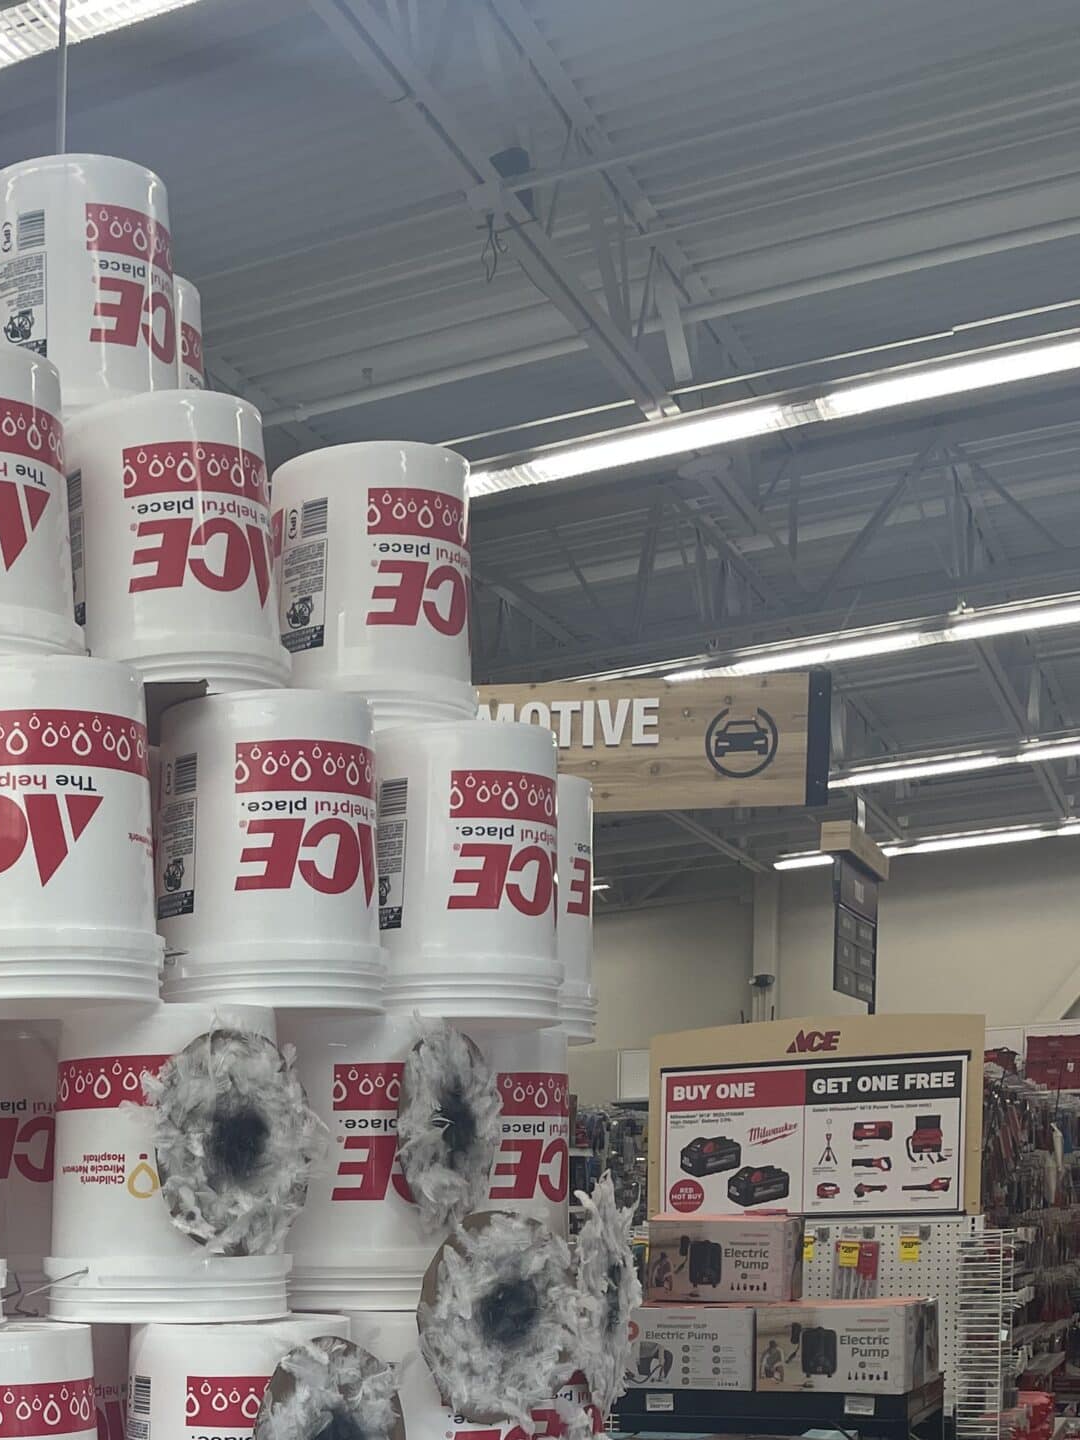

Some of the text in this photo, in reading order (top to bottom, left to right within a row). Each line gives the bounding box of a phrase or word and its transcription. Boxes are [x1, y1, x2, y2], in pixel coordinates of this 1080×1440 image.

[16, 465, 46, 487] The
[132, 497, 193, 514] place.
[374, 543, 430, 557] place.
[56, 775, 97, 791] The
[242, 797, 306, 814] place.
[456, 825, 514, 840] place.
[786, 1030, 841, 1052] ACE
[812, 1072, 955, 1094] GET ONE FREE
[673, 1082, 755, 1101] BUY ONE
[83, 1152, 125, 1163] Hospitals
[90, 1165, 125, 1174] Miracle
[80, 1175, 125, 1184] Children's
[724, 1248, 769, 1258] Electric
[735, 1260, 769, 1270] Pump
[645, 1331, 718, 1341] Electric Pump
[840, 1335, 889, 1345] Electric
[851, 1347, 889, 1358] Pump
